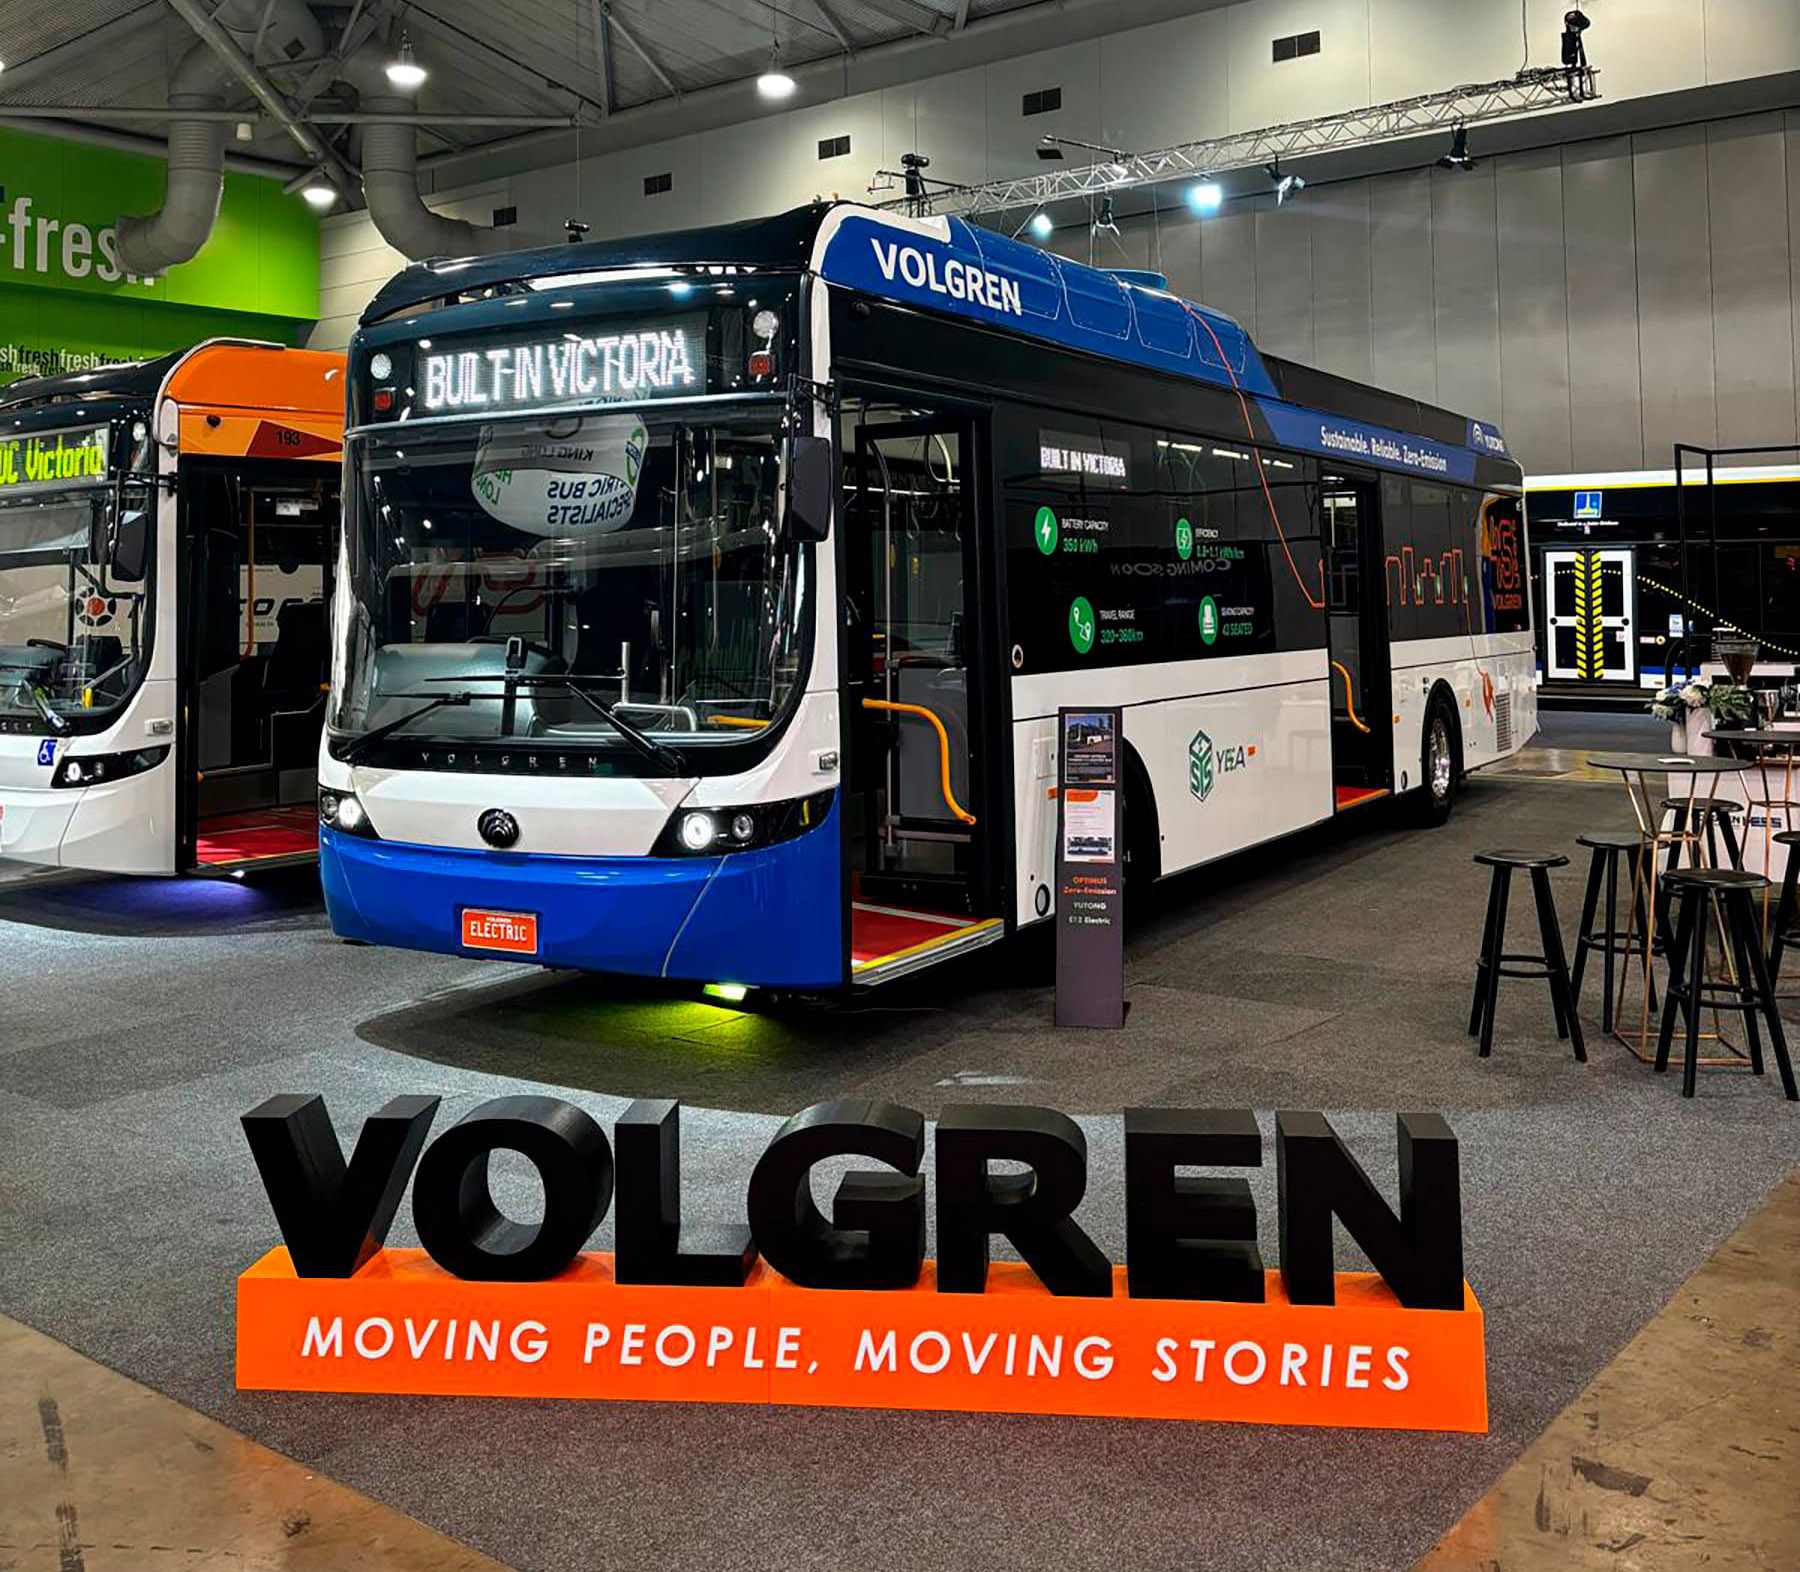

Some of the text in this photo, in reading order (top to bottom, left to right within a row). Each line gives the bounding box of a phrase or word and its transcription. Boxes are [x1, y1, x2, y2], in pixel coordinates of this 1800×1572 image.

[870, 237, 1022, 316] VOLGREN
[547, 329, 693, 396] VICTORIA
[25, 434, 104, 480] Victoria
[277, 430, 300, 446] 193
[422, 752, 597, 769] VOLGREN
[1216, 745, 1246, 774] YEA
[470, 920, 528, 942] ELECTRIC
[241, 1093, 1465, 1311] VOLGREN
[301, 1316, 1411, 1391] MOVING PEOPLE, MOVING STORIES
